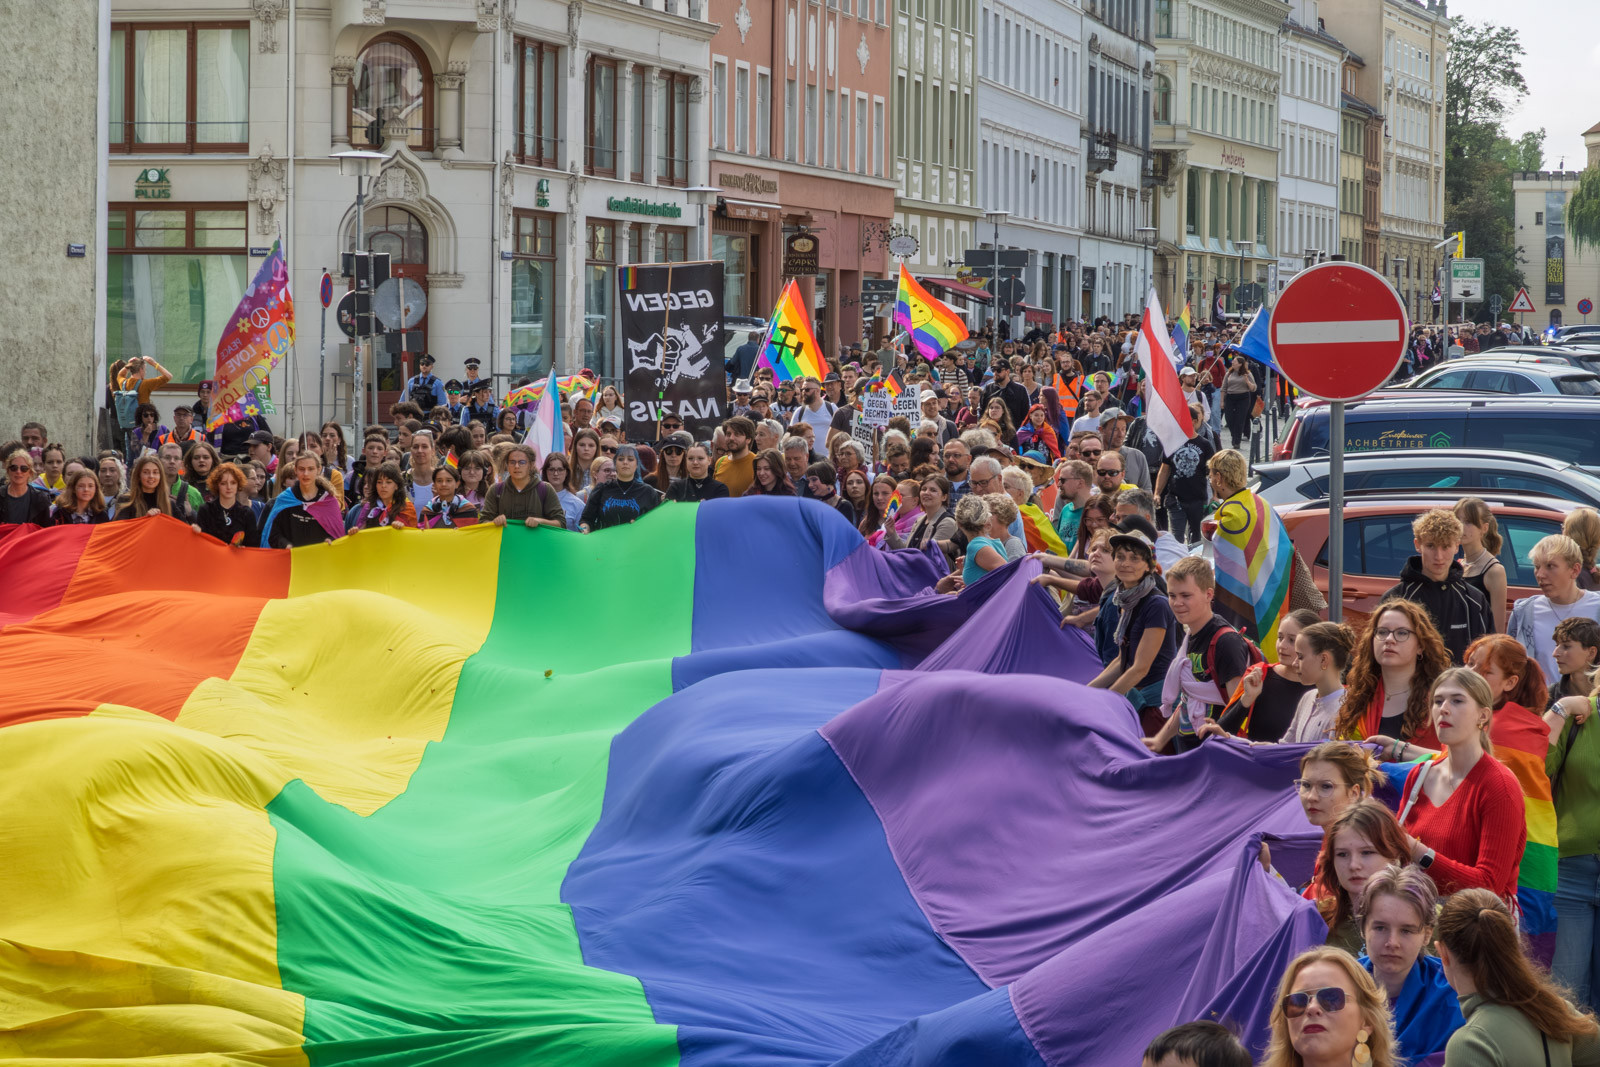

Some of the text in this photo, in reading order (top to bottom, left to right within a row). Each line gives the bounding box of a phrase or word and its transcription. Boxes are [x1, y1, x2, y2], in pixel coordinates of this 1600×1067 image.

[1220, 144, 1245, 168] Ambiente
[135, 168, 170, 183] AOK
[135, 189, 171, 198] PLUS
[256, 385, 275, 415] PEACE
[867, 399, 888, 409] GEGEN
[893, 400, 917, 411] GEGEN
[864, 409, 888, 419] RECHTS
[1346, 439, 1424, 448] ACHBETRIEB
